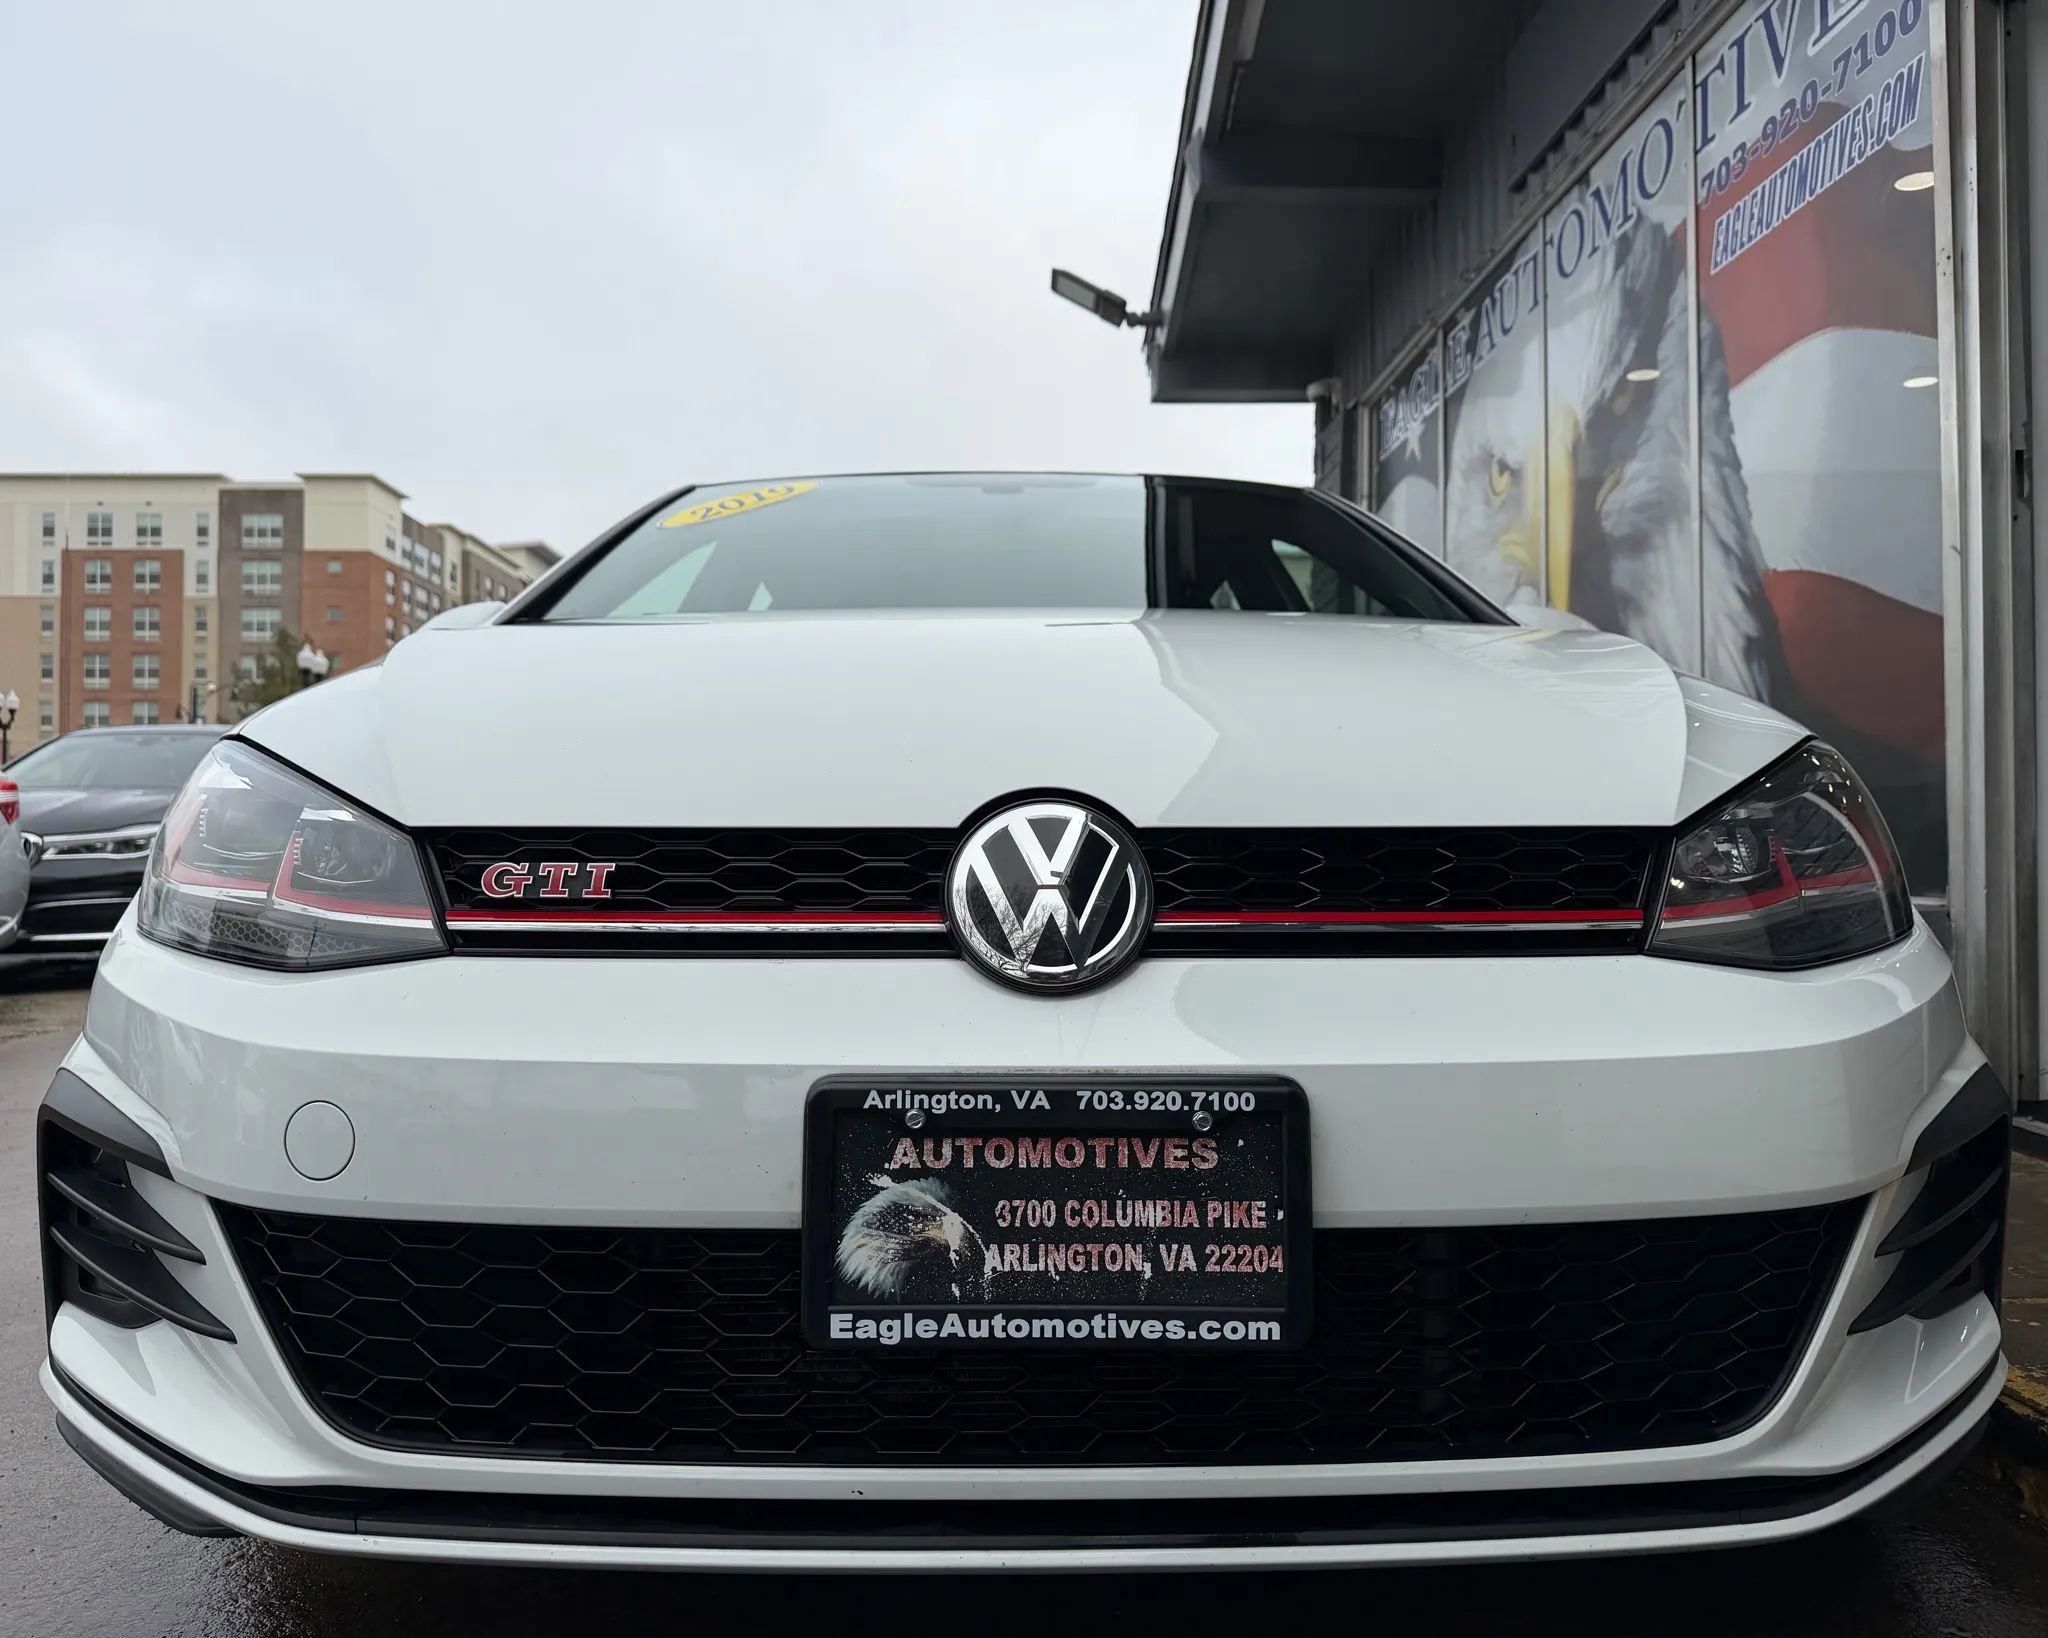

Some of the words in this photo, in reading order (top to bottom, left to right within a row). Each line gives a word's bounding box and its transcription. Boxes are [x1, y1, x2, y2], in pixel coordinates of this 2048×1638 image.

[1699, 0, 1923, 208] 703-920-7100
[1711, 51, 1926, 275] EAGLEAUTOMOTIVES.COM
[481, 862, 616, 898] GTI
[863, 1089, 1001, 1114] Arlington,
[1010, 1090, 1050, 1110] VA
[1076, 1090, 1256, 1112] 703.920.7100
[889, 1137, 1219, 1169] AUTOMOTIVES
[995, 1199, 1057, 1228] 3700
[1064, 1199, 1200, 1229] COLUMBIA
[1207, 1200, 1267, 1228] PIKE
[1159, 1244, 1197, 1272] VA
[1205, 1244, 1284, 1273] 22204
[829, 1312, 1281, 1346] EagleAutomotives.com
